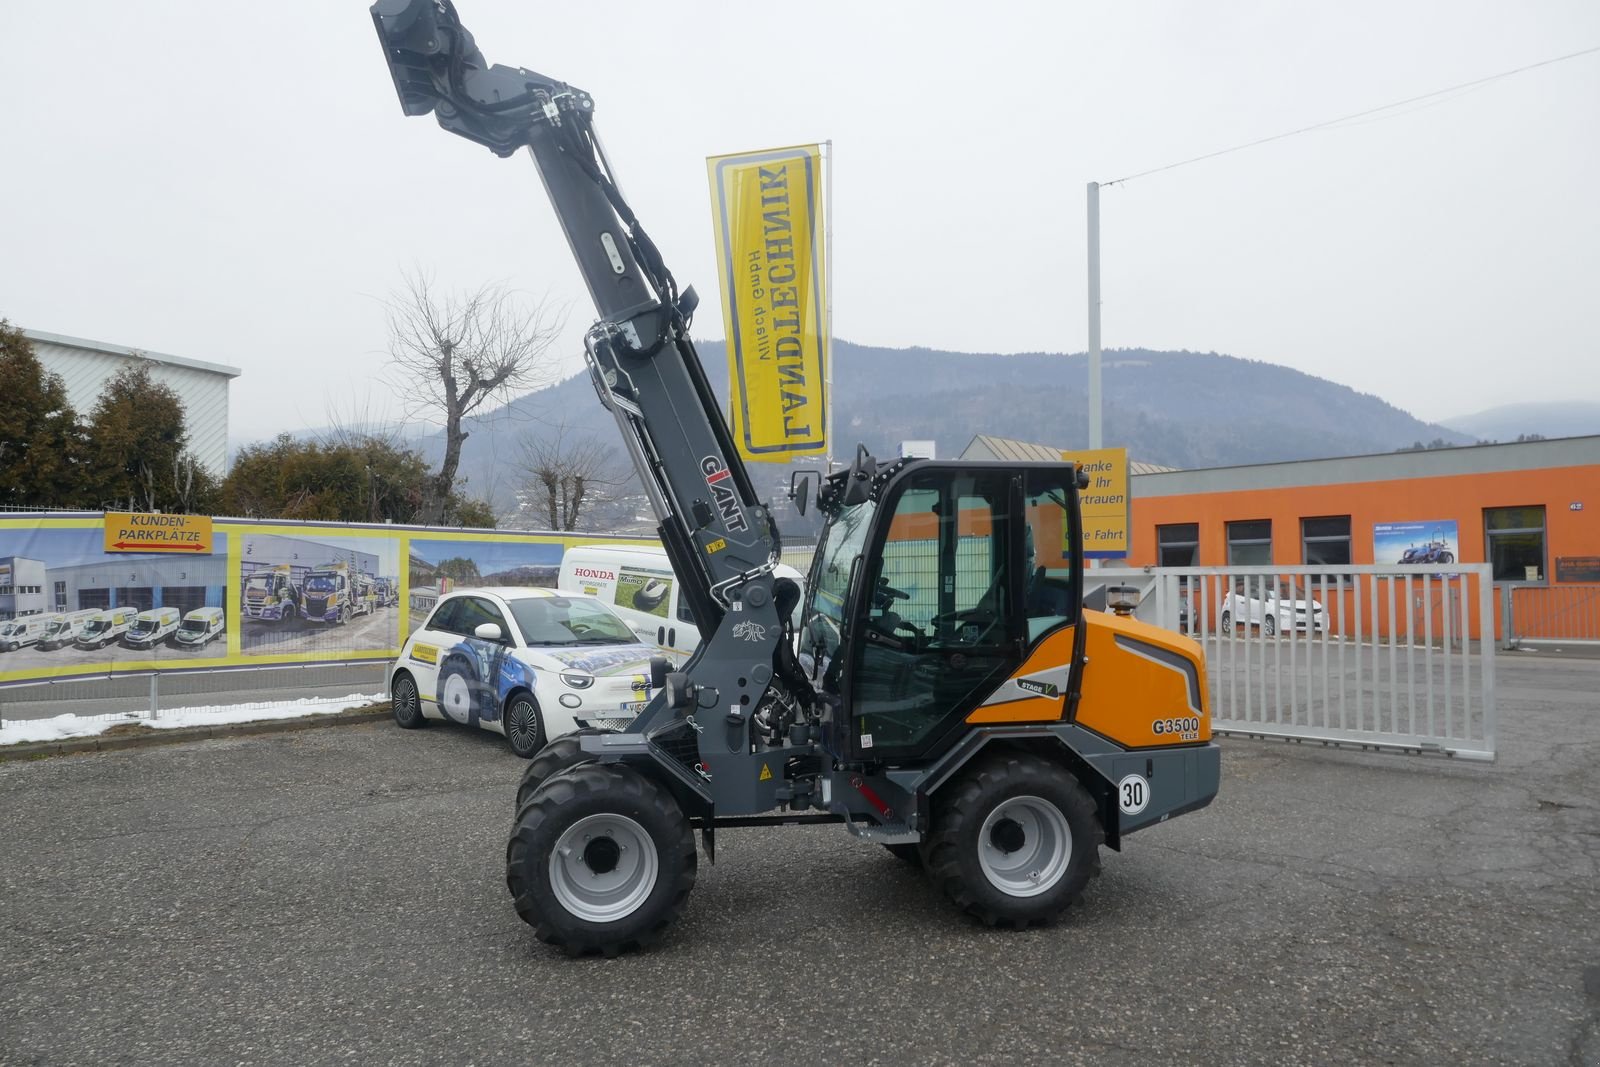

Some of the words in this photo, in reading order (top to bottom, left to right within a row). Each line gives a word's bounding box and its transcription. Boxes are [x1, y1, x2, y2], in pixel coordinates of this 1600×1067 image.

[1080, 460, 1112, 473] anke
[1096, 477, 1112, 488] Ihr
[1080, 495, 1124, 504] rtrauen
[130, 515, 191, 527] KUNDEN-
[118, 527, 201, 541] PARKPLÄTZE
[1095, 528, 1124, 540] Fahrt
[574, 568, 615, 580] HONDA
[1021, 682, 1043, 692] STAGE
[1152, 718, 1199, 734] G3500
[1181, 732, 1198, 740] TELE
[1123, 782, 1143, 807] 30
